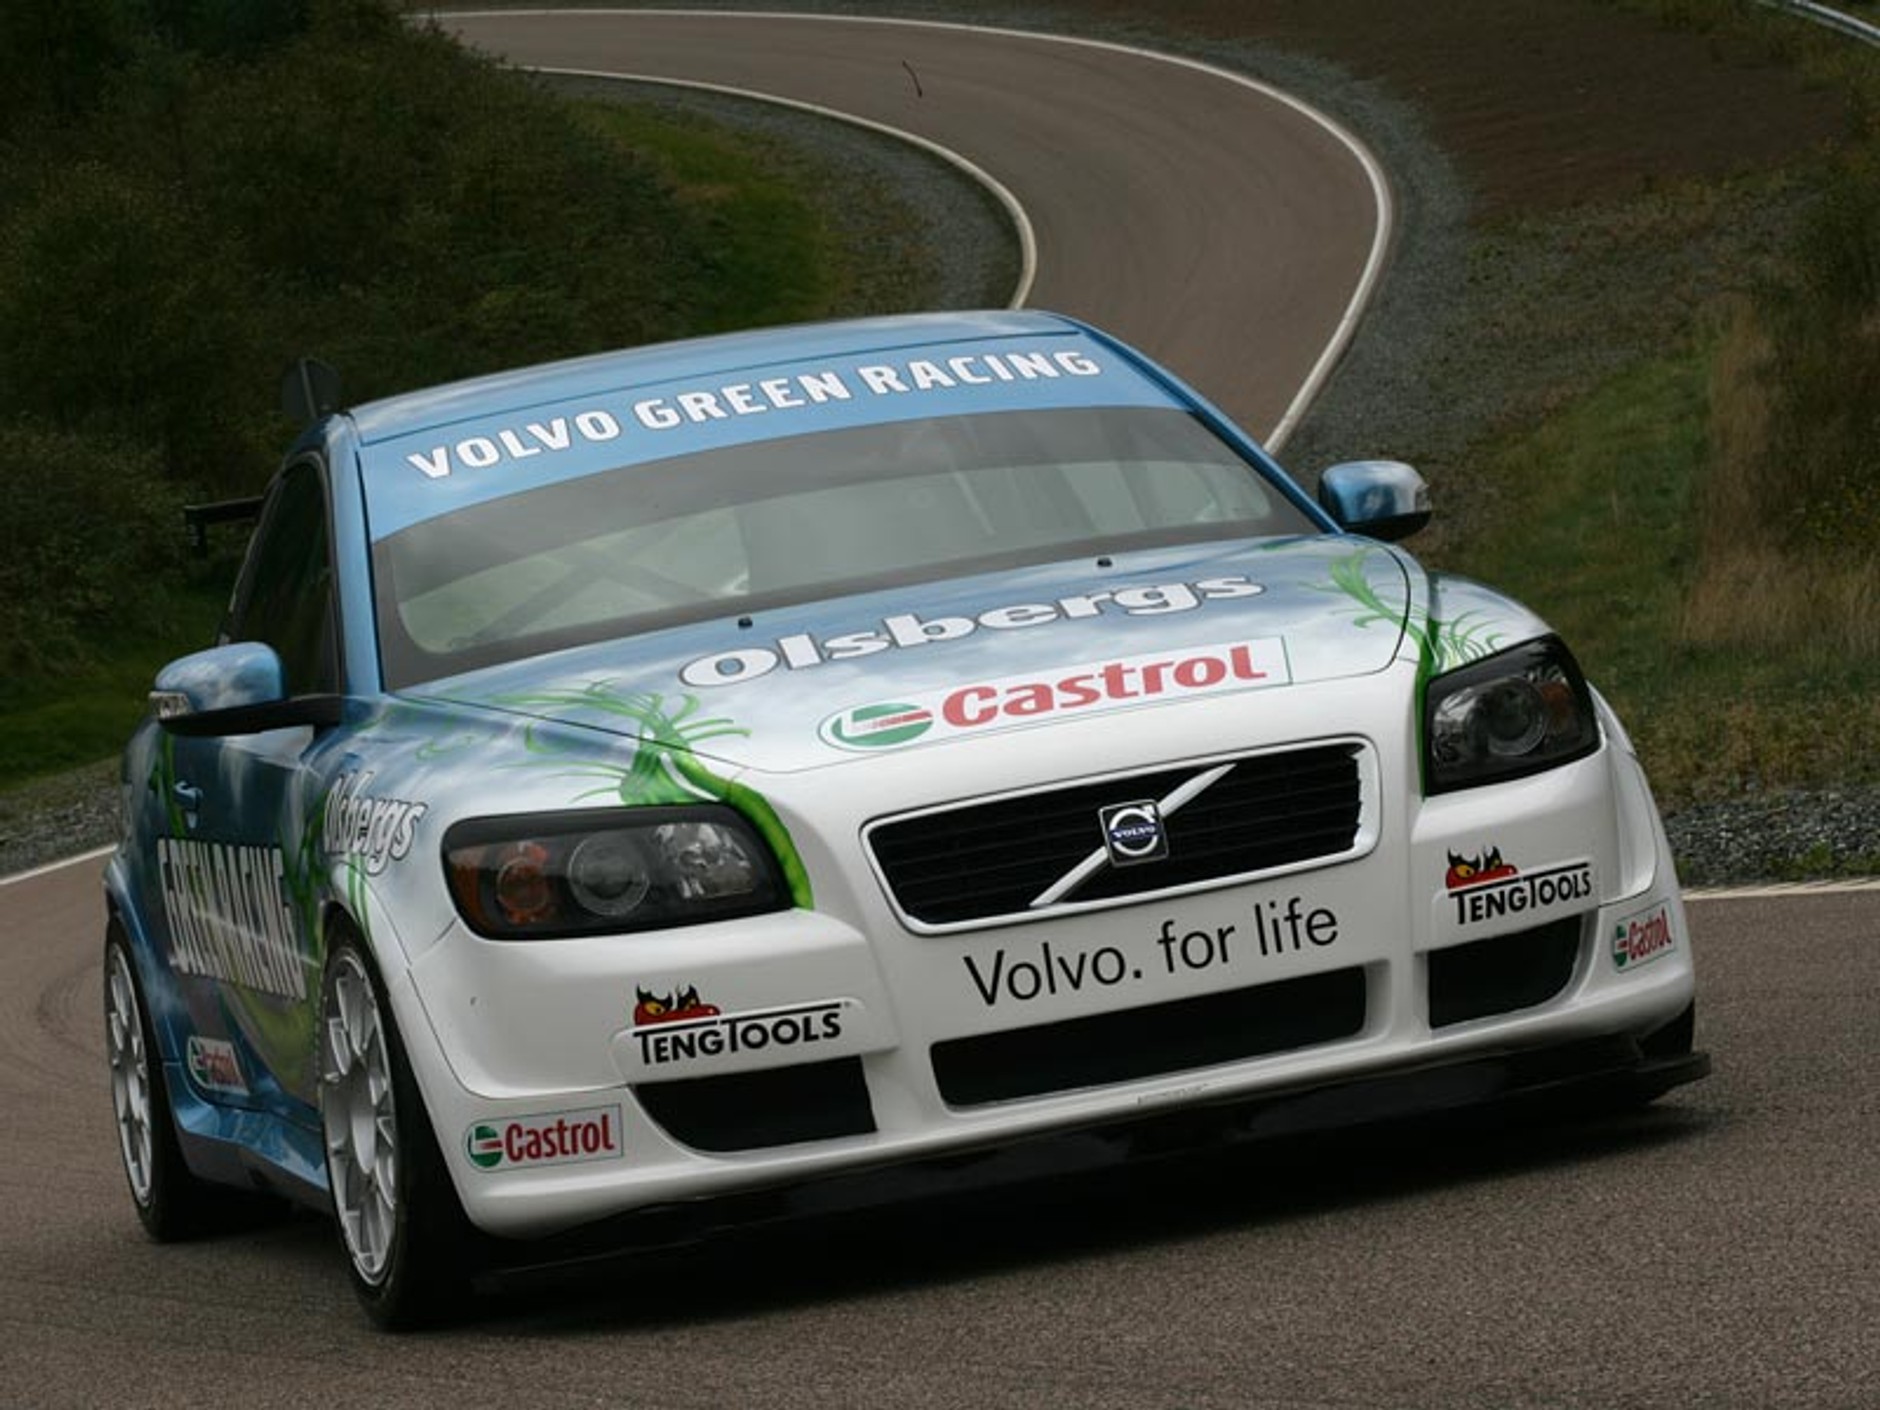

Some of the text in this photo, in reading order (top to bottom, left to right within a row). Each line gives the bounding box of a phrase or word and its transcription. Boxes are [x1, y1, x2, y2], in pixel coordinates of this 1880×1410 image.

[406, 349, 1101, 479] VOLVO GREEN RACING
[678, 575, 1268, 687] Olsbergs
[942, 645, 1268, 728] Castrol
[323, 770, 429, 876] Olsbergs
[1112, 825, 1156, 838] VOLVO
[963, 897, 1339, 1006] Volvo. for life
[1627, 906, 1673, 960] Castrol
[505, 1113, 615, 1163] Castrol
